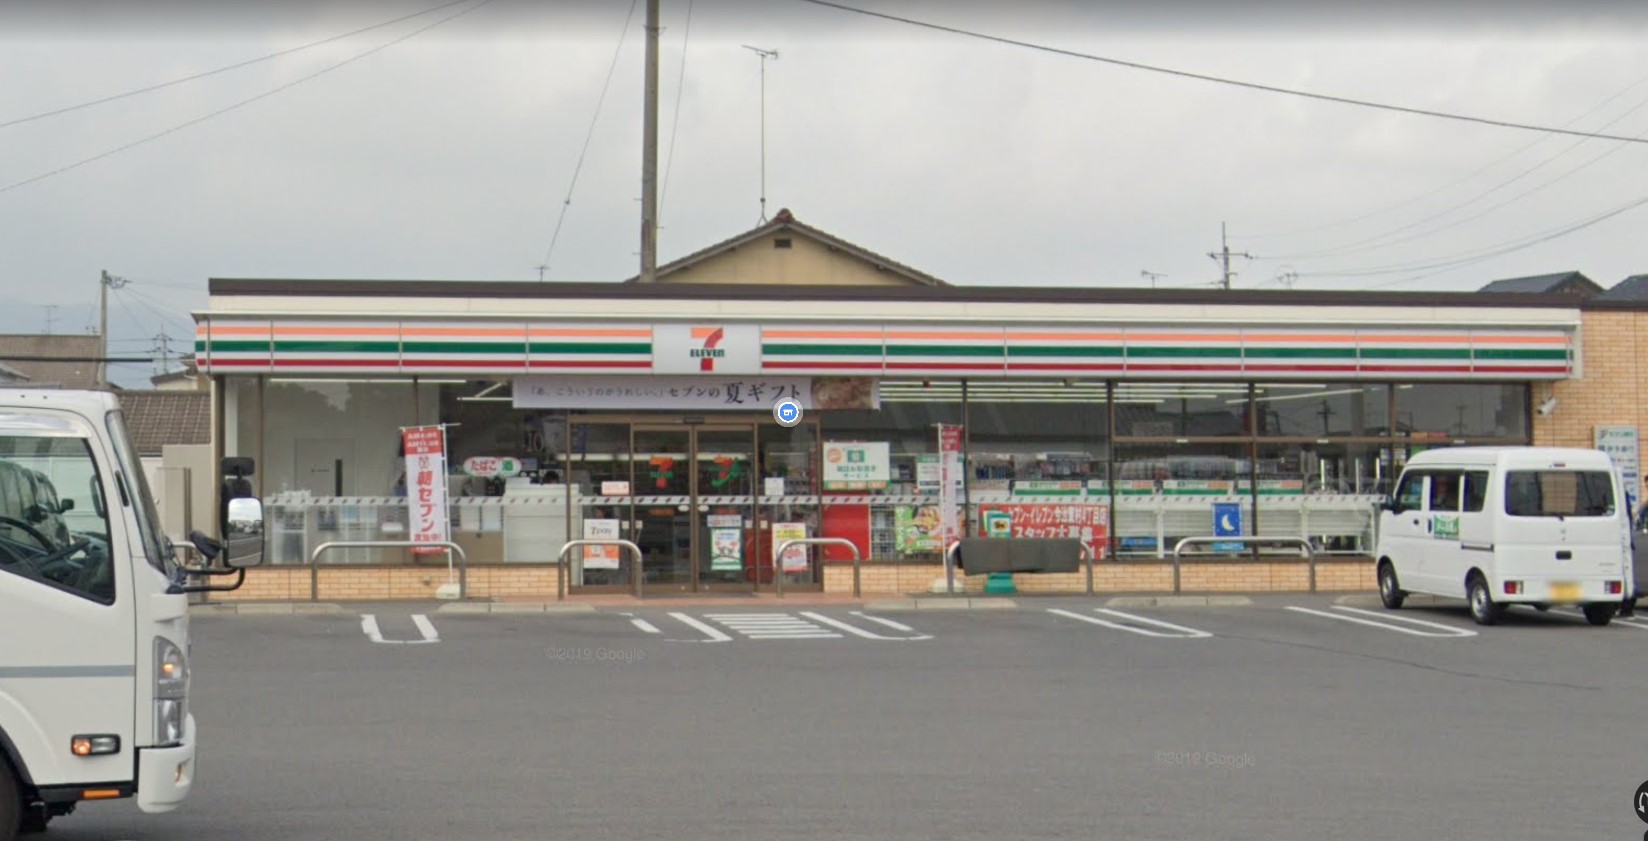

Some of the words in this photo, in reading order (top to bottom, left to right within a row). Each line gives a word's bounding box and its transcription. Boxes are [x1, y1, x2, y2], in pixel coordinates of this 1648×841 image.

[691, 327, 724, 371] 7
[470, 460, 497, 472] たばこ
[417, 471, 435, 532] 朝セブン
